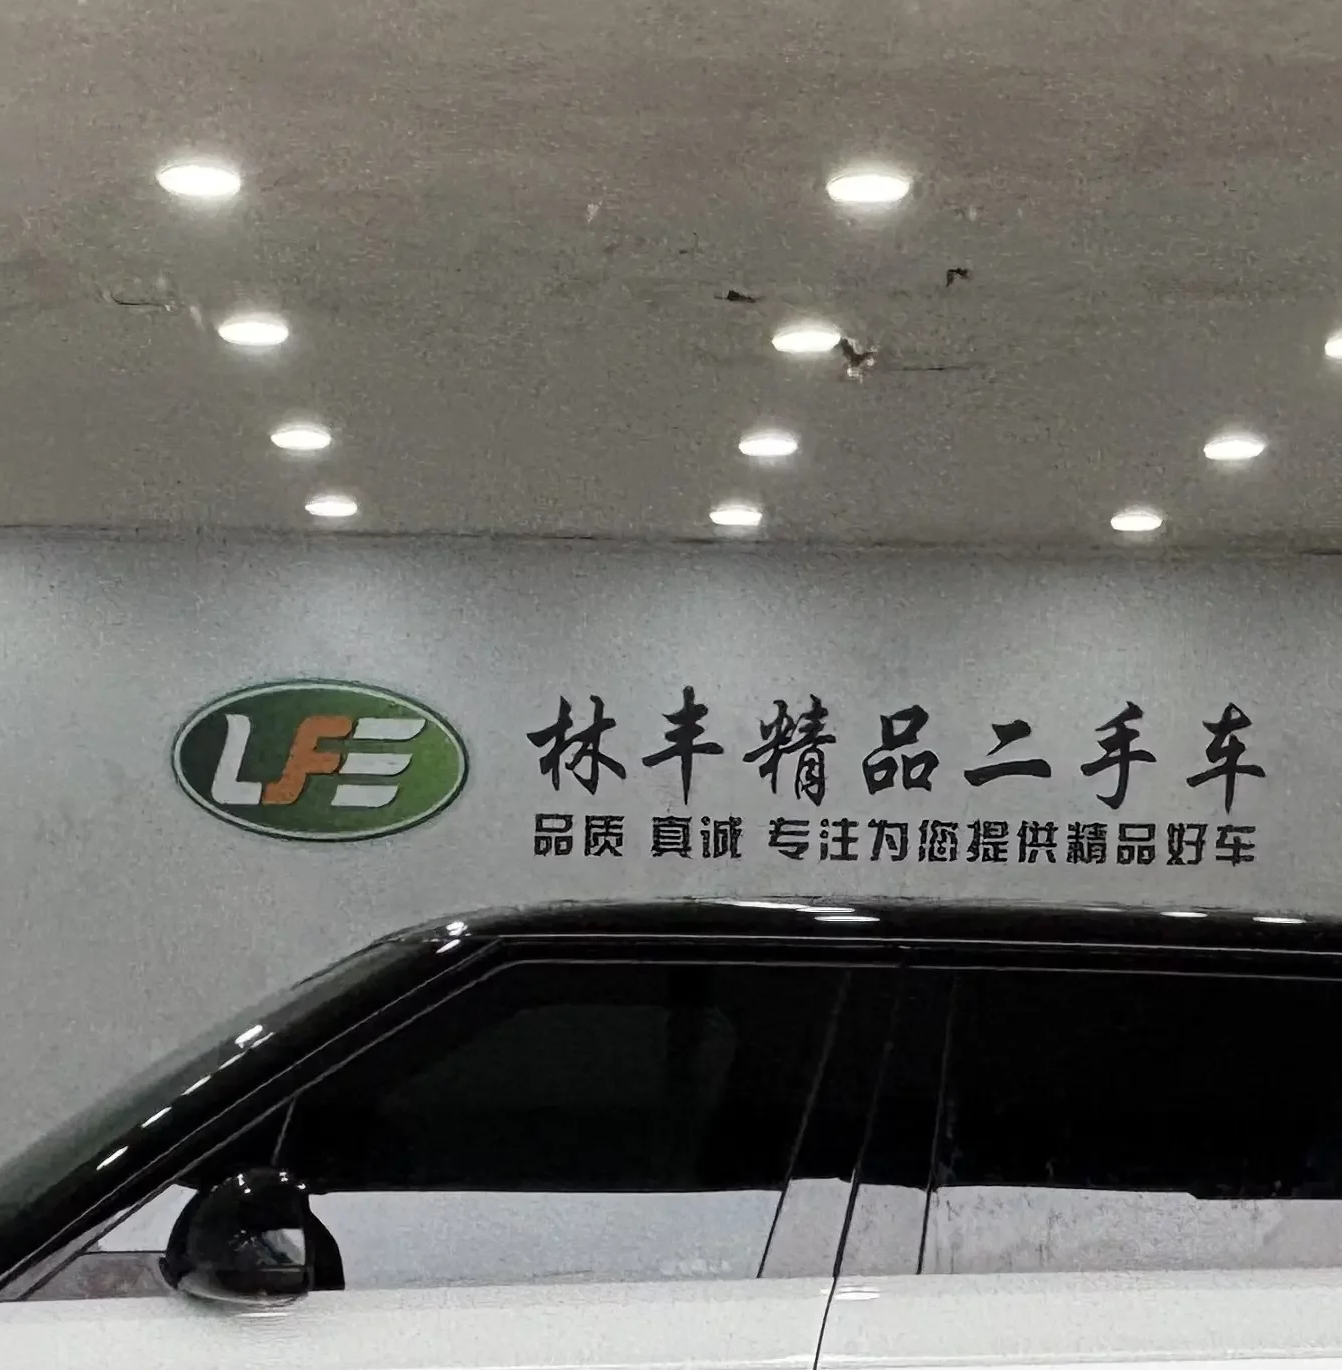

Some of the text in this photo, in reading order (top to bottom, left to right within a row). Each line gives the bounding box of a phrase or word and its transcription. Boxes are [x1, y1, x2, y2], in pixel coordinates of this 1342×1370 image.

[525, 684, 1268, 815] 林丰精品二手车
[532, 812, 1257, 868] 品质 真诚 专注为您提供精品好车
